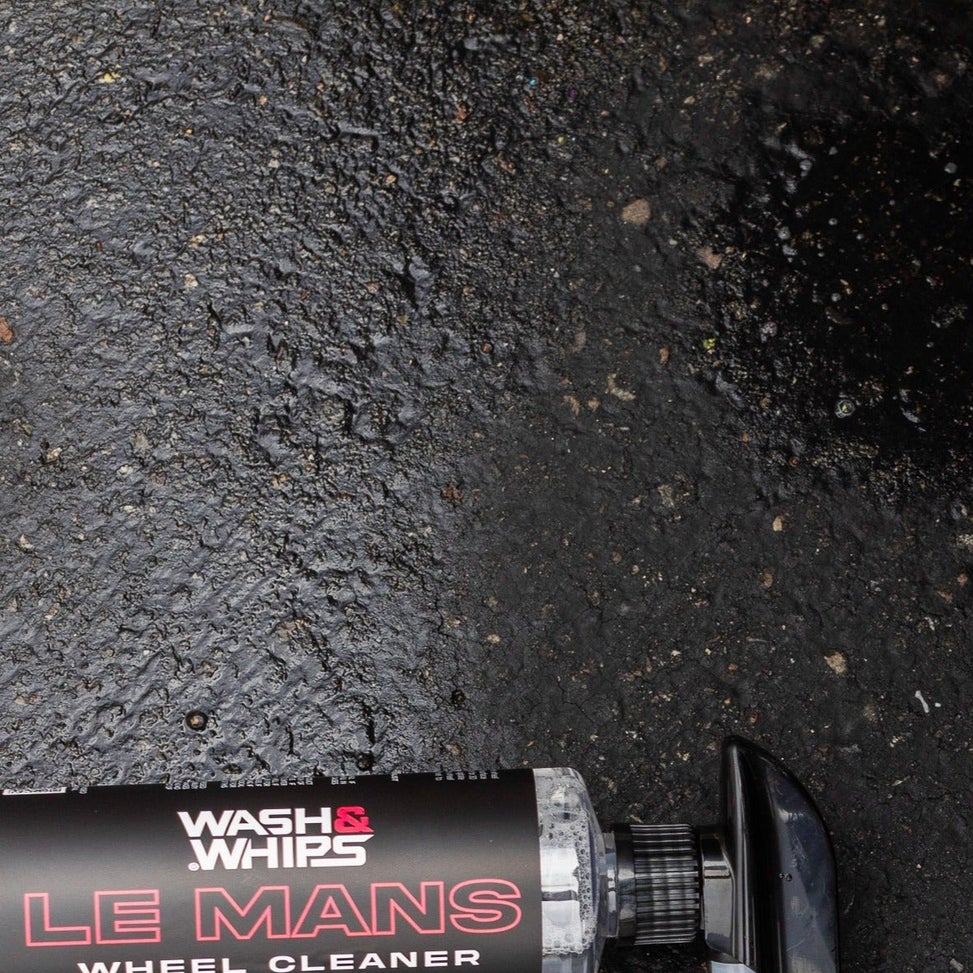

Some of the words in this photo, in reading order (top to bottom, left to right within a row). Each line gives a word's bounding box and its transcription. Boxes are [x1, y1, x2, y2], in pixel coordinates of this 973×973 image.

[188, 834, 375, 871] WHIPS
[23, 889, 162, 947] LE
[195, 876, 523, 942] MANS
[268, 949, 481, 973] CLEANER
